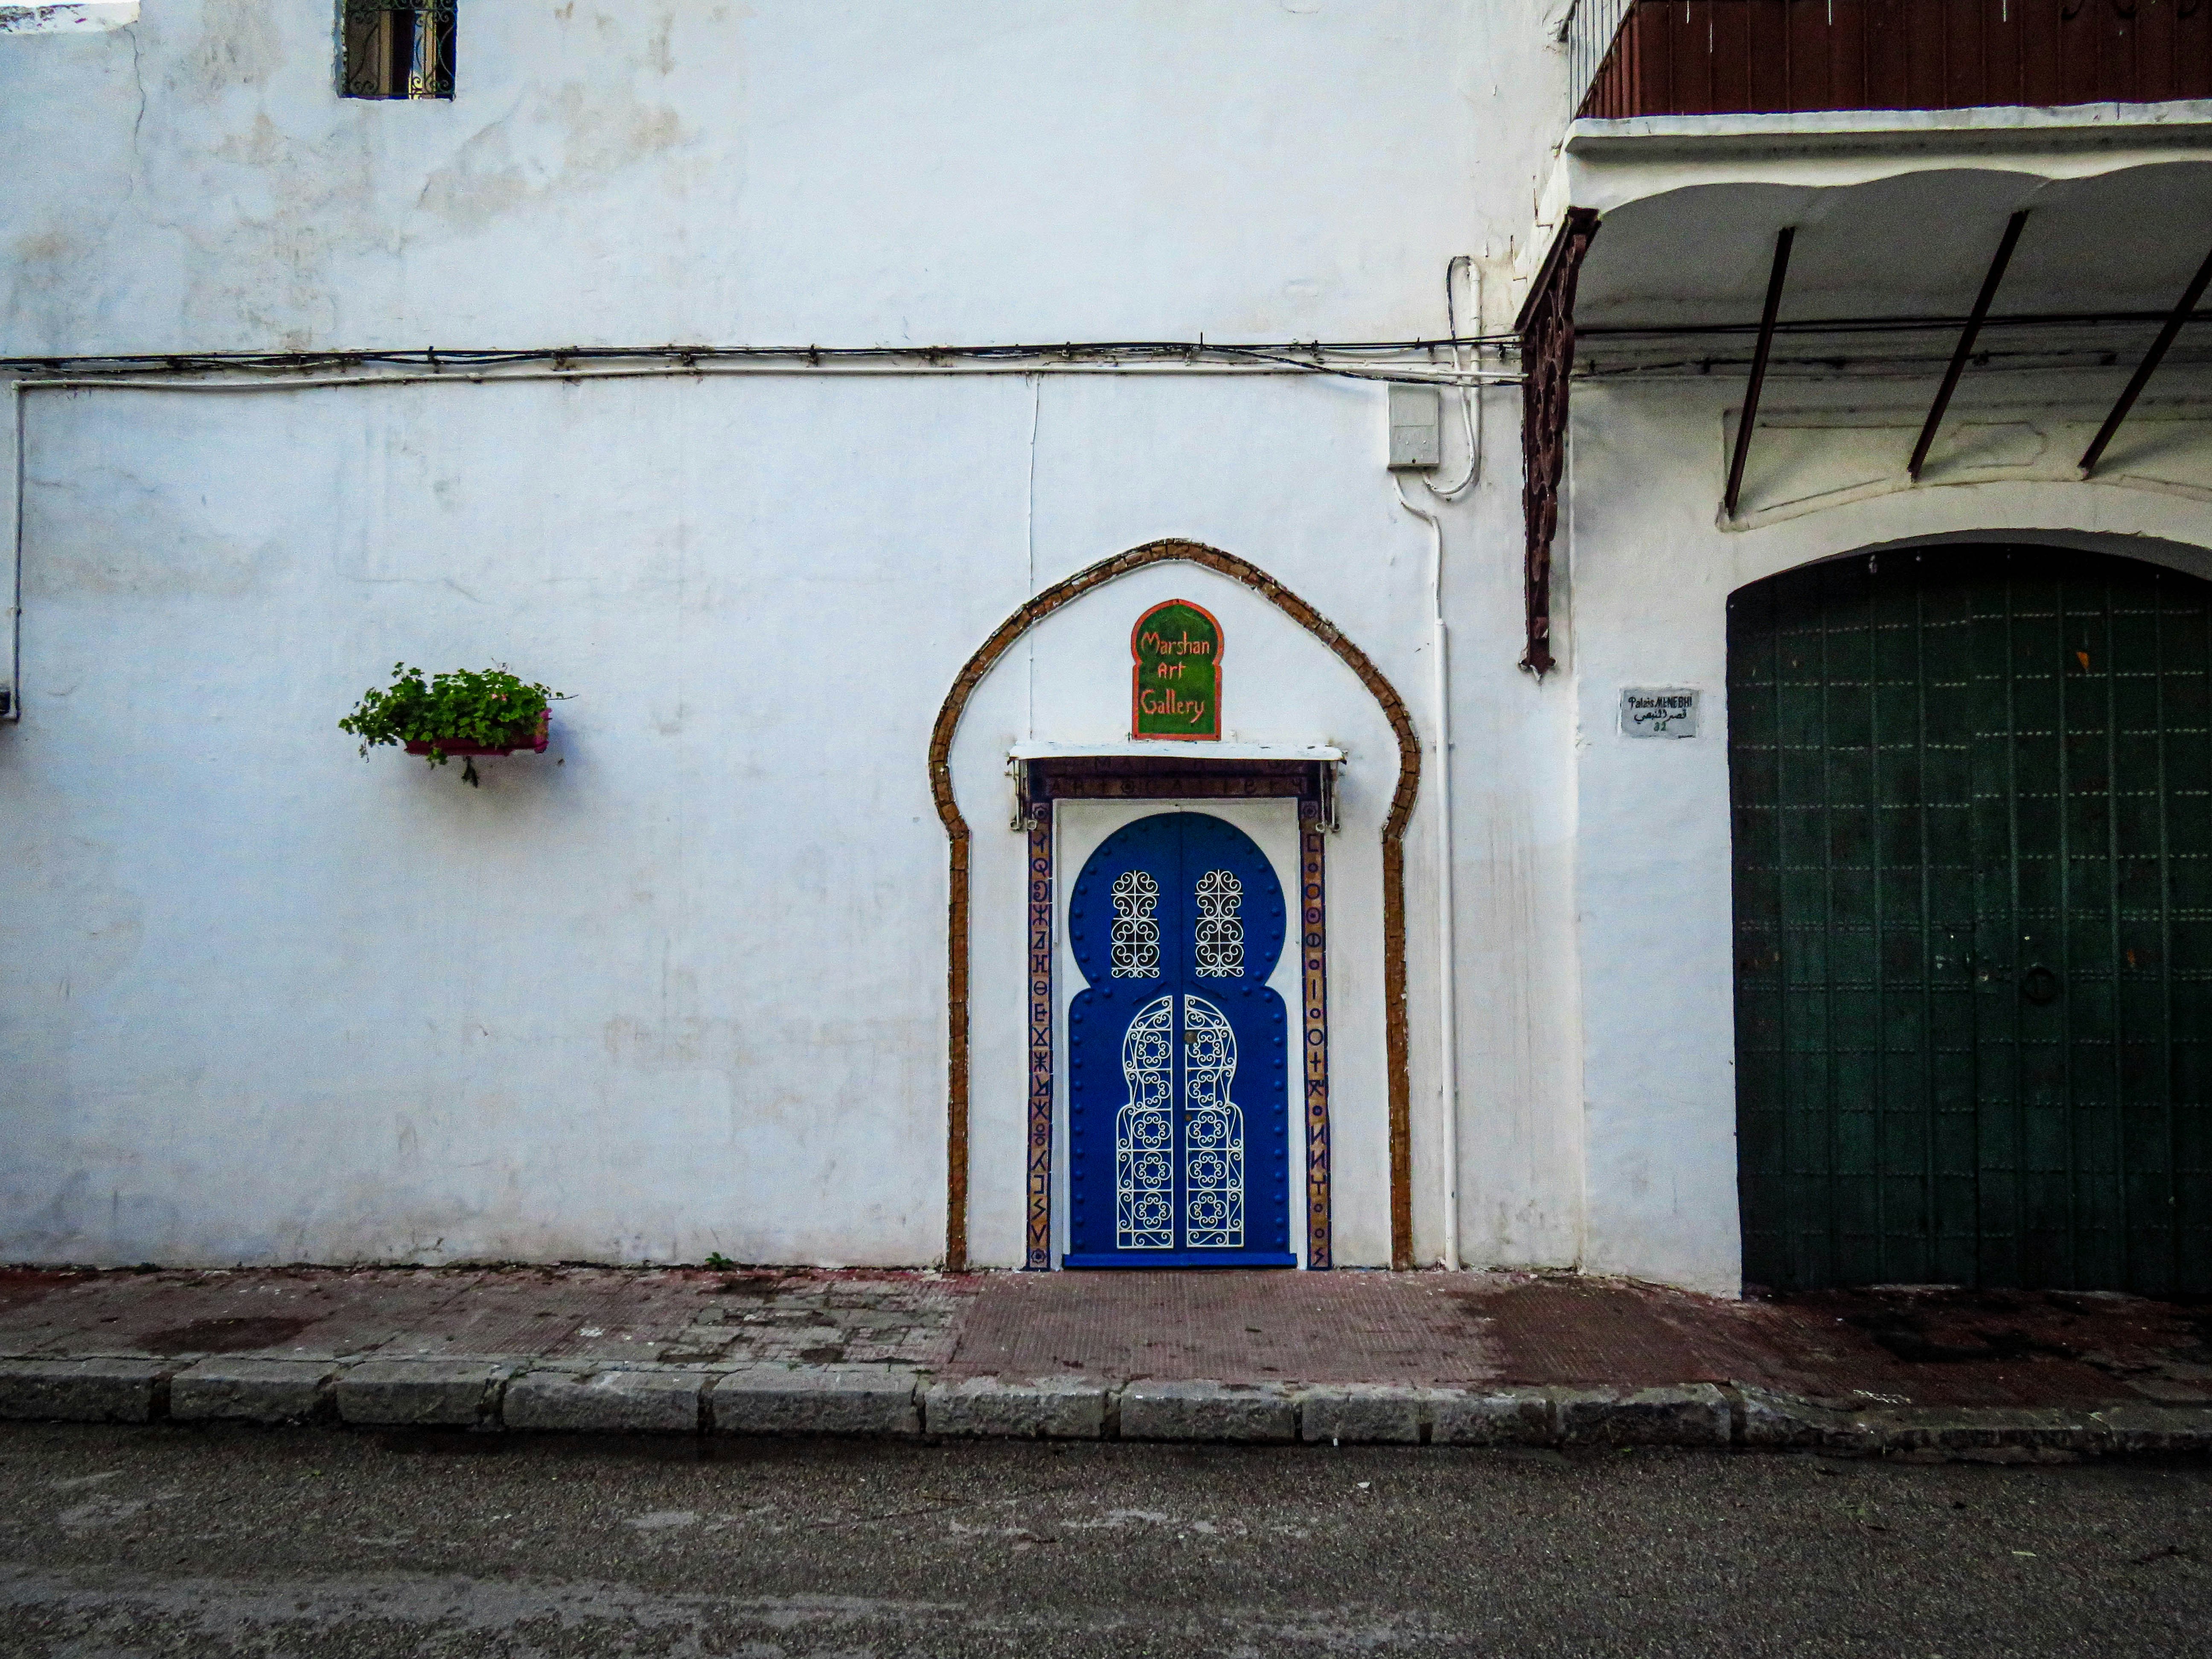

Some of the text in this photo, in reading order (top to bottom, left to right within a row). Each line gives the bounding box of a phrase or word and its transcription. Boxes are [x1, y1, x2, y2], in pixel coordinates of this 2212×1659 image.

[1141, 631, 1210, 655] Marshan
[1157, 661, 1187, 680] Art
[1140, 689, 1204, 723] Gallery
[1628, 696, 1654, 710] Palais
